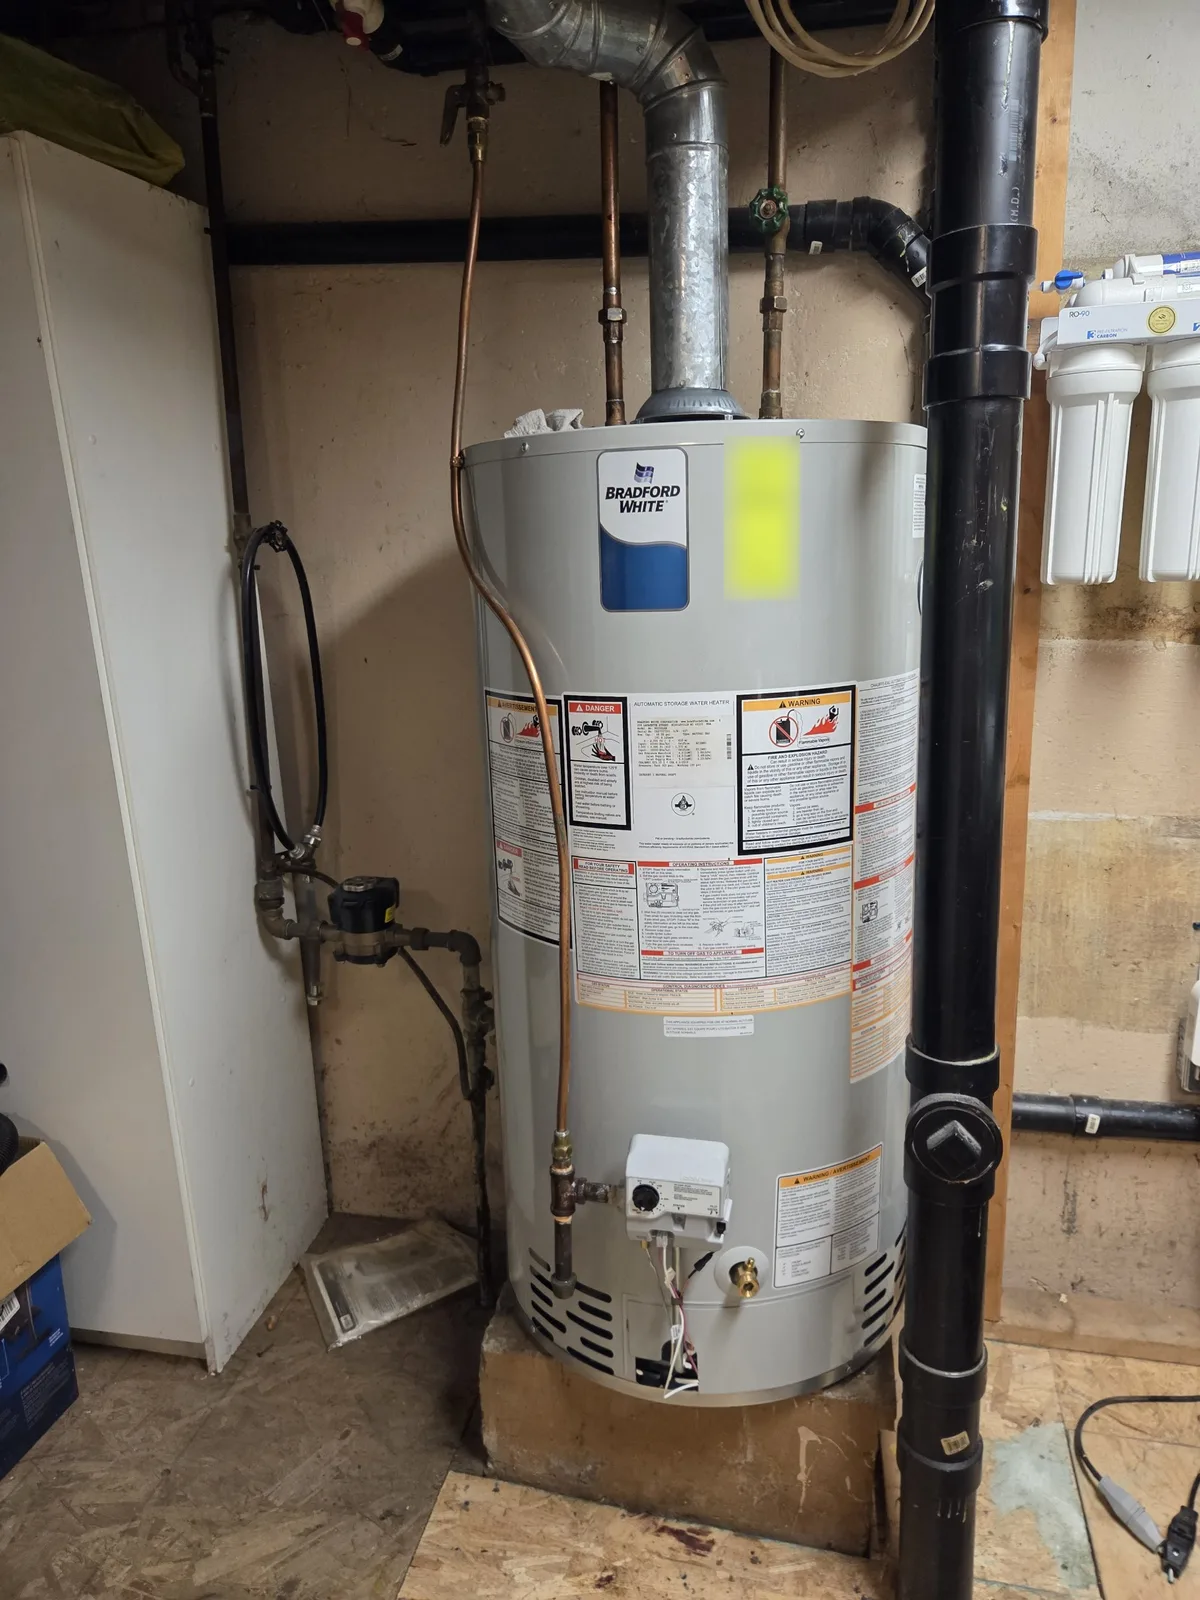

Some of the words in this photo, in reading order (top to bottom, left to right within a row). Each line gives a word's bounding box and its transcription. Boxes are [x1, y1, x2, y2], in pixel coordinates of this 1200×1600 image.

[1070, 310, 1090, 318] RO-90
[605, 485, 680, 500] BRADFORD
[619, 500, 664, 513] WHITE
[788, 698, 820, 707] WARNING
[803, 1171, 829, 1182] WARNING
